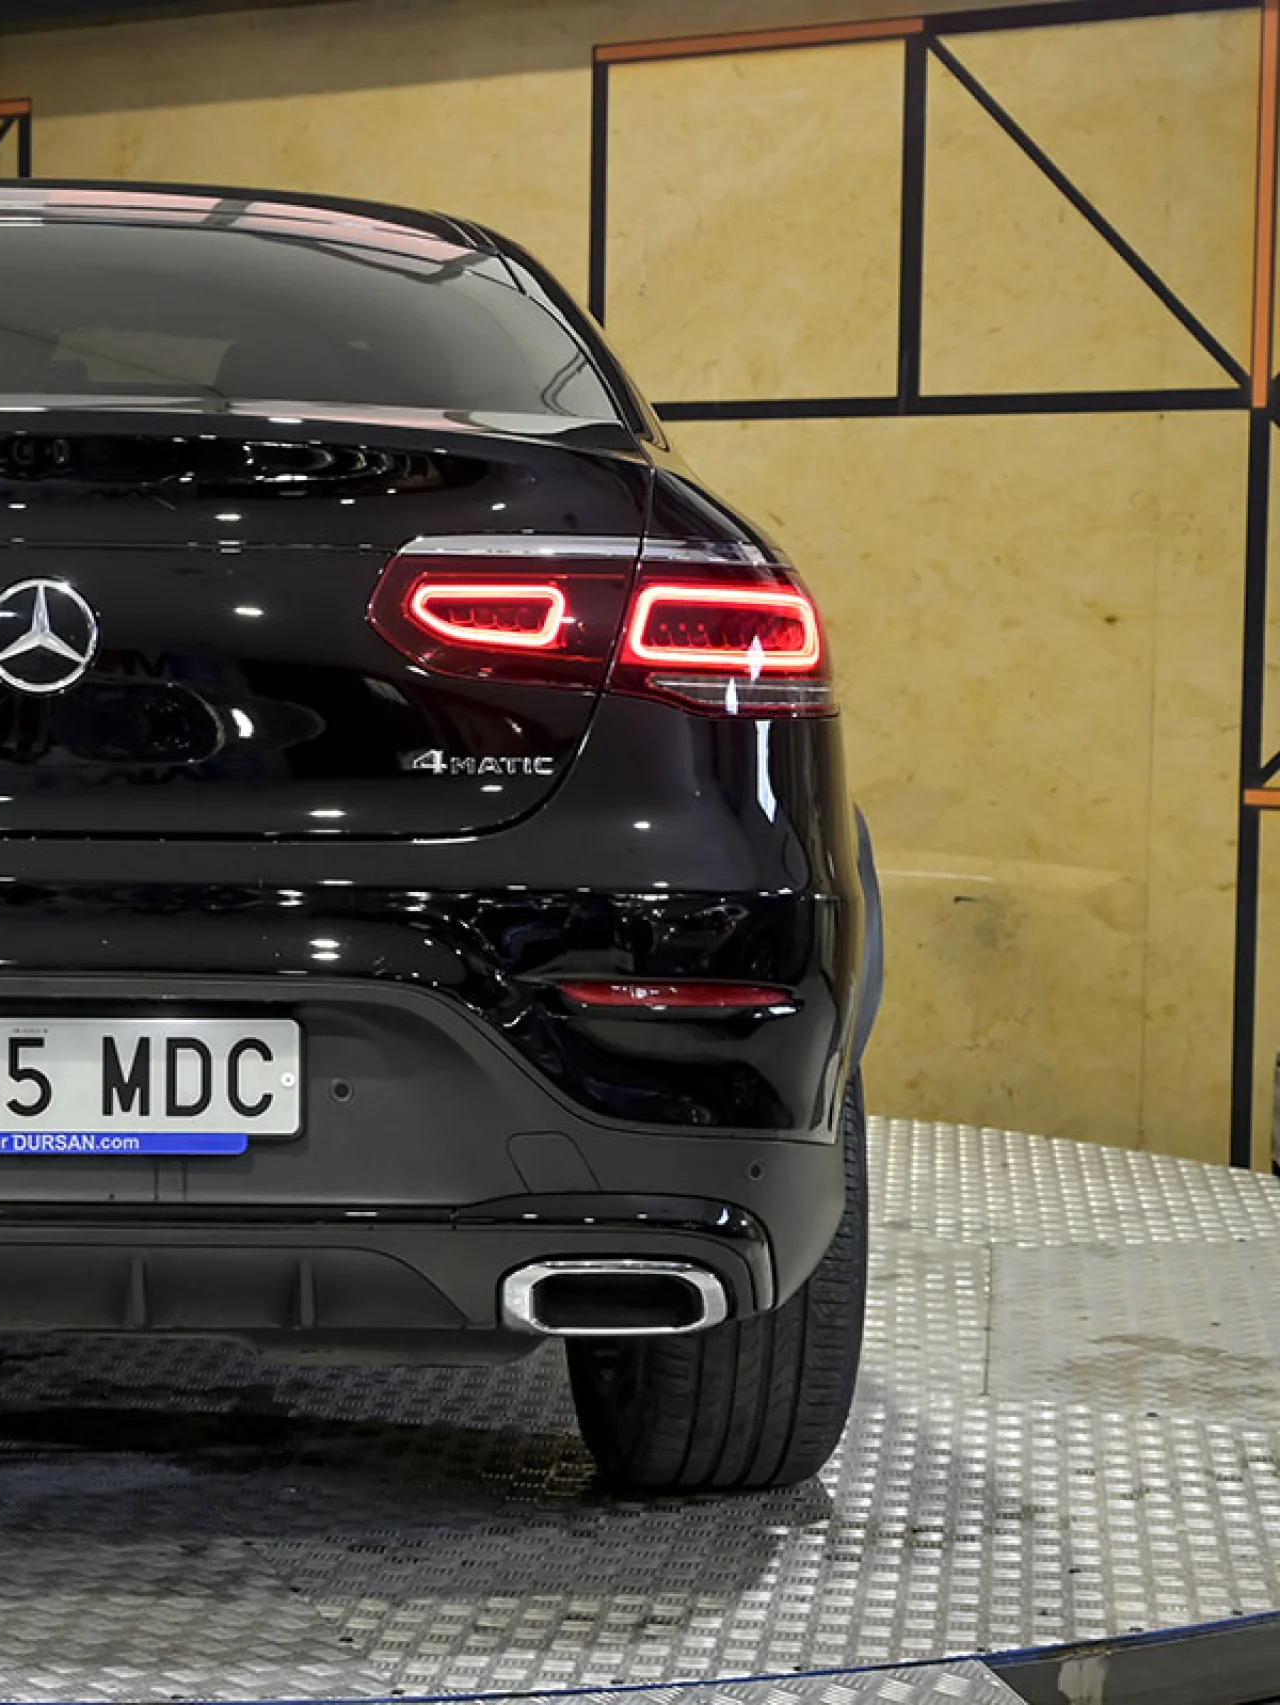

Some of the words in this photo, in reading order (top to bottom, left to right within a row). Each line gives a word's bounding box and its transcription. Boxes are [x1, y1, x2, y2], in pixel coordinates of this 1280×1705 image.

[410, 748, 554, 775] 4MATIC
[102, 1036, 274, 1117] MDC
[12, 1133, 140, 1151] DURSAN.com
